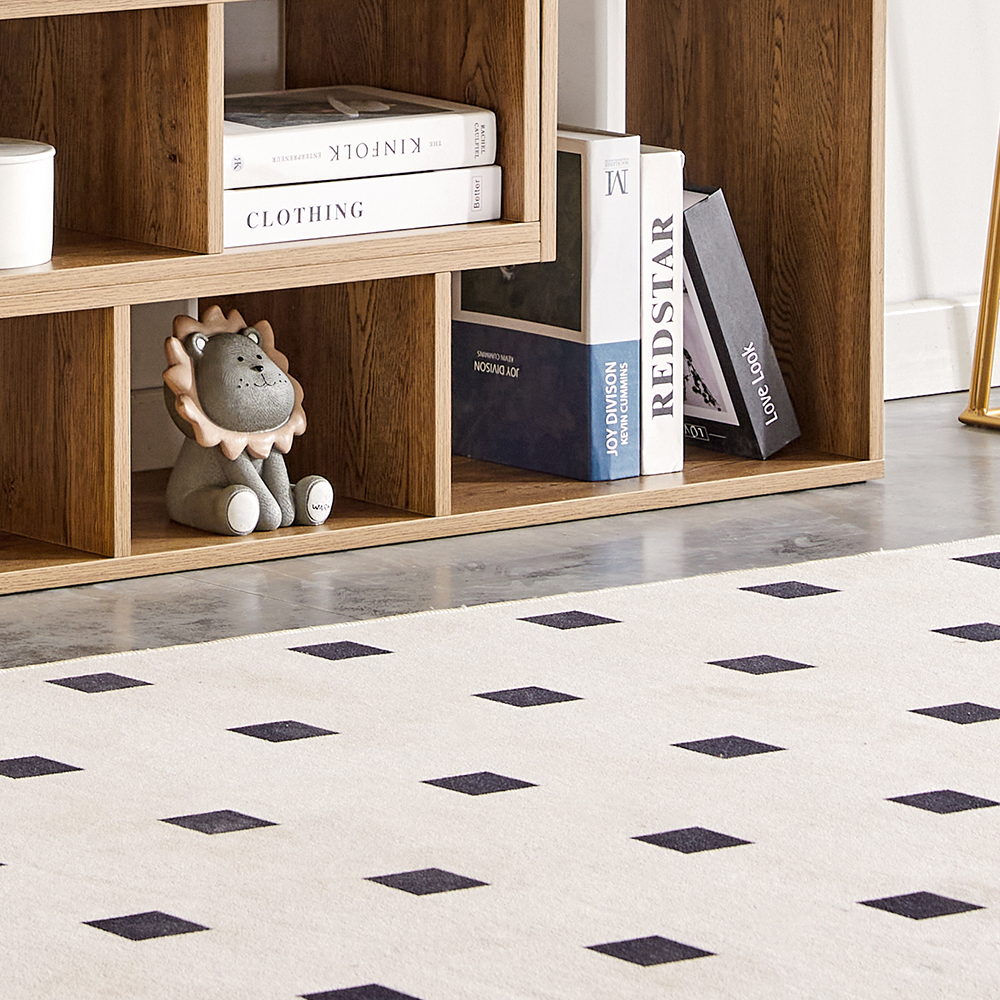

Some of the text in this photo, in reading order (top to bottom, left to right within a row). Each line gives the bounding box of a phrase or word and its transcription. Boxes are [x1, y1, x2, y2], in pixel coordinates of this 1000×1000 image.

[328, 137, 421, 162] KINFOLK
[429, 140, 442, 148] THE
[604, 168, 629, 197] M
[246, 200, 364, 229] CLOTHING
[473, 360, 520, 378] JOY DIVISON
[476, 350, 514, 363] KEVIN CUMMINS
[741, 341, 779, 426] Love Look
[604, 361, 619, 457] JOY DIVISON
[619, 361, 629, 446] KEVIN CUMMINS
